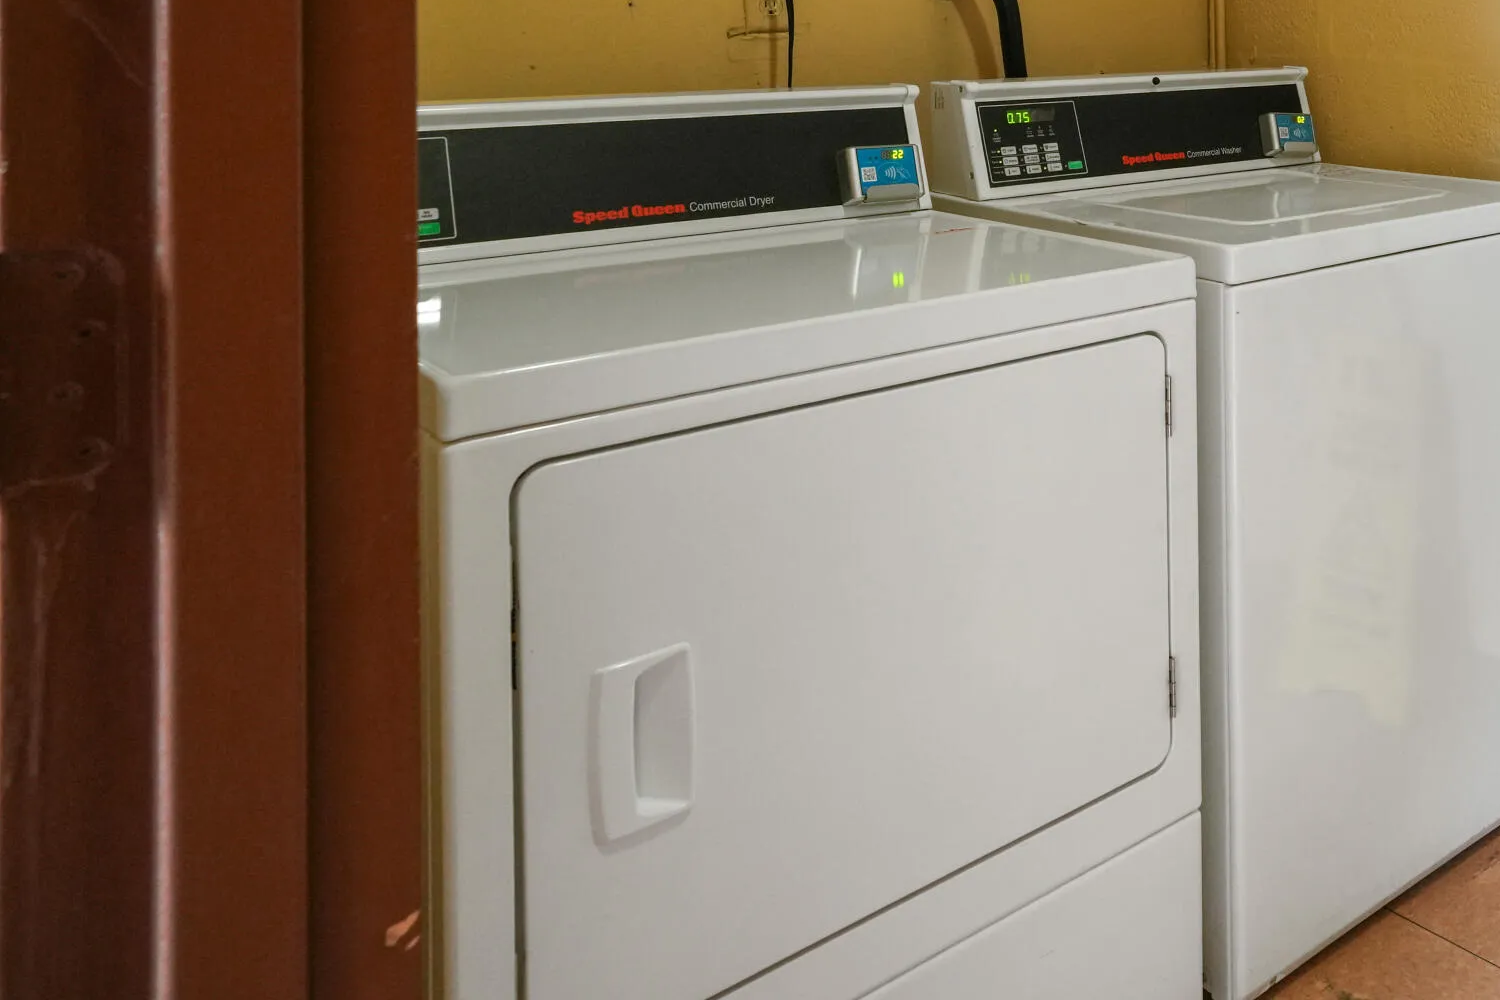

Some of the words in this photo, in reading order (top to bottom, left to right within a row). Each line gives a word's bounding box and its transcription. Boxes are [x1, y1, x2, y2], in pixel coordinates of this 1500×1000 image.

[1122, 153, 1154, 166] Speed
[1154, 151, 1186, 162] Queen
[1186, 147, 1221, 160] Commercial
[572, 206, 629, 226] Speed
[631, 202, 686, 219] Queen
[688, 197, 748, 214] Commercial
[749, 193, 776, 211] Dryer
